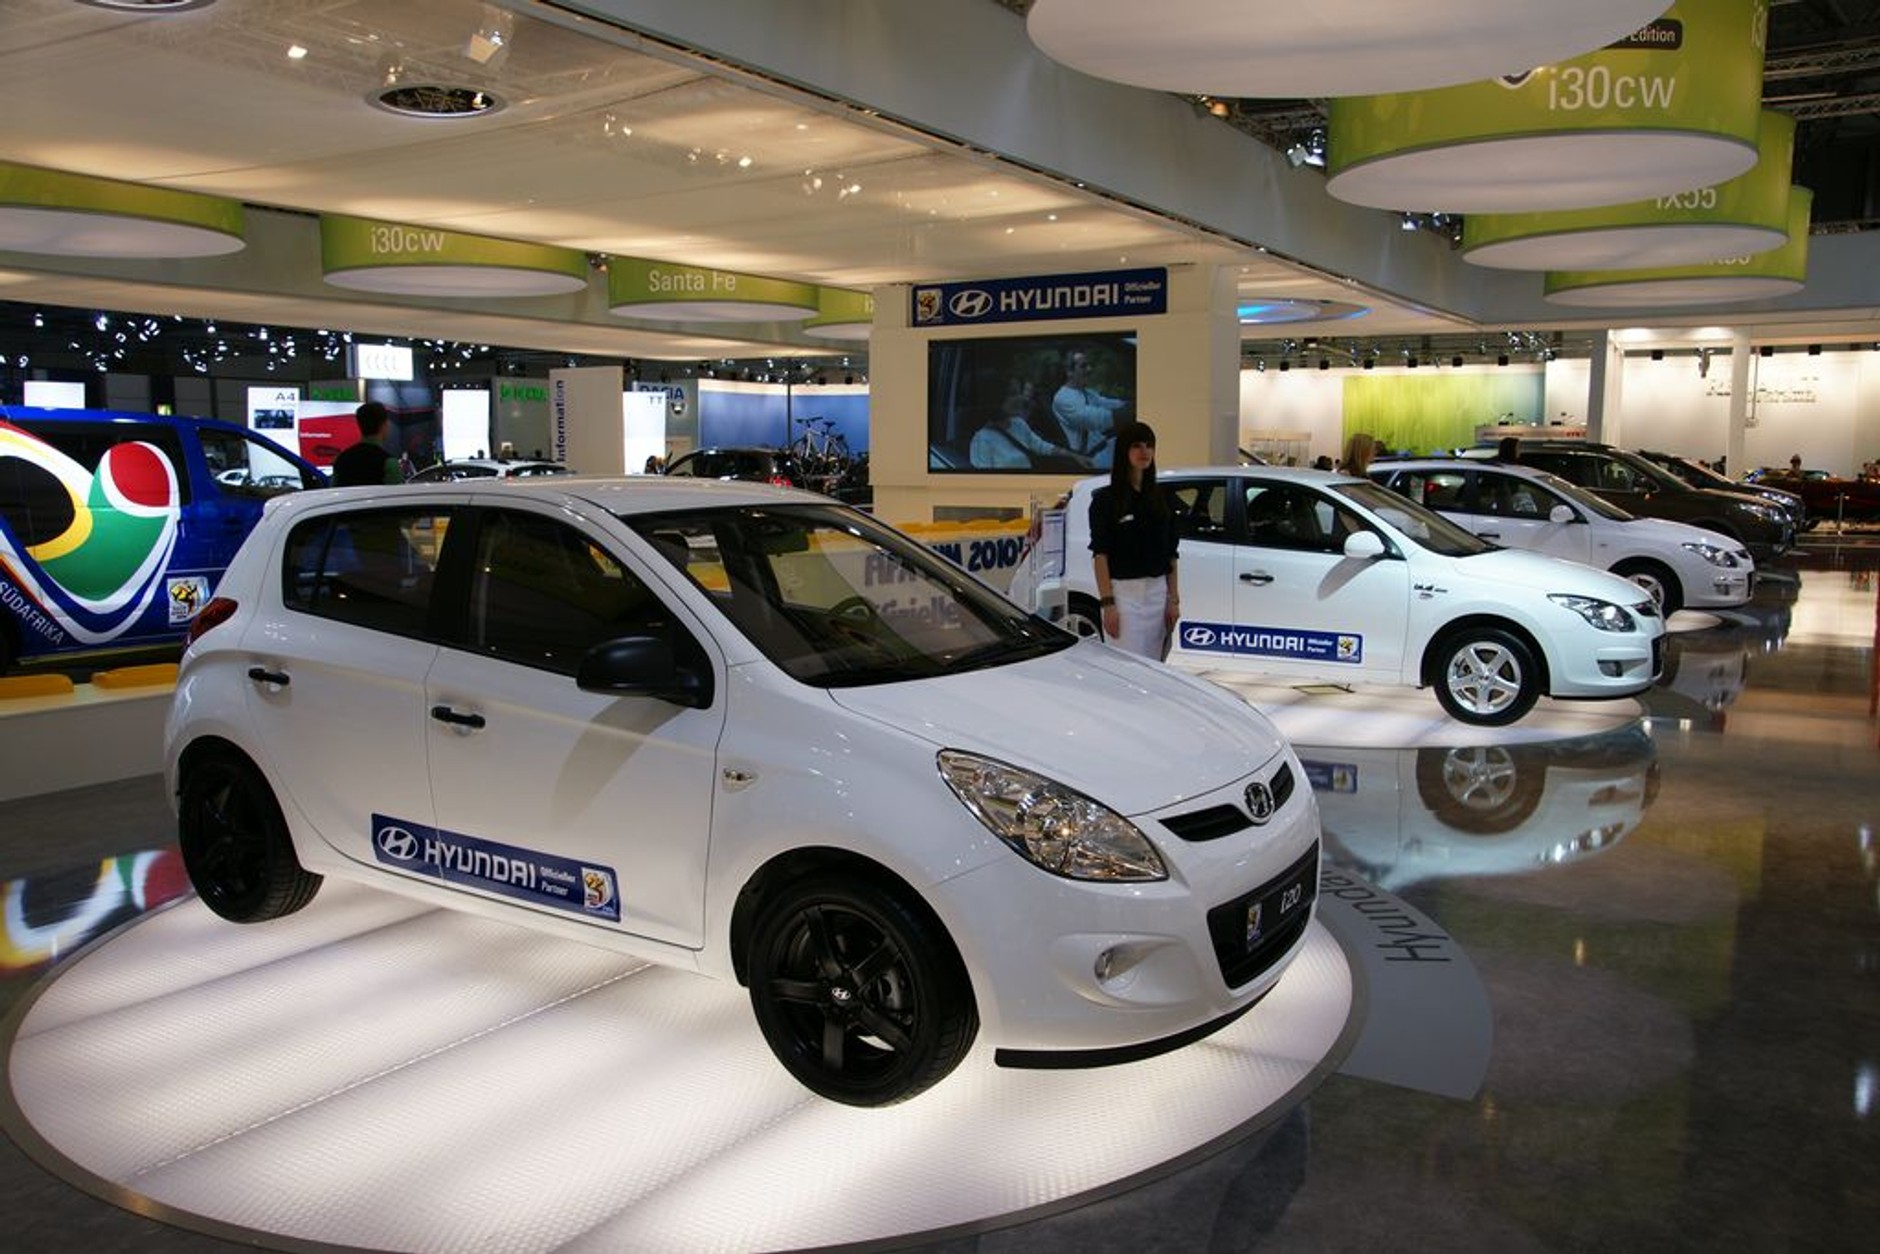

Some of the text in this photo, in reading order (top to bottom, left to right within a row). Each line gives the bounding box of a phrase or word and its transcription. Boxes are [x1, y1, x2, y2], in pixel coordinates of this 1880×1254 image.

[1549, 66, 1676, 111] i30cw
[370, 226, 445, 254] i30cw
[649, 269, 736, 293] Santa Fe
[1000, 283, 1119, 312] HYUNDAI
[275, 392, 295, 402] A4
[555, 380, 567, 462] Information
[1220, 632, 1304, 651] HYUNDAI
[425, 838, 536, 889] HYUNDAI
[1280, 883, 1301, 914] i20
